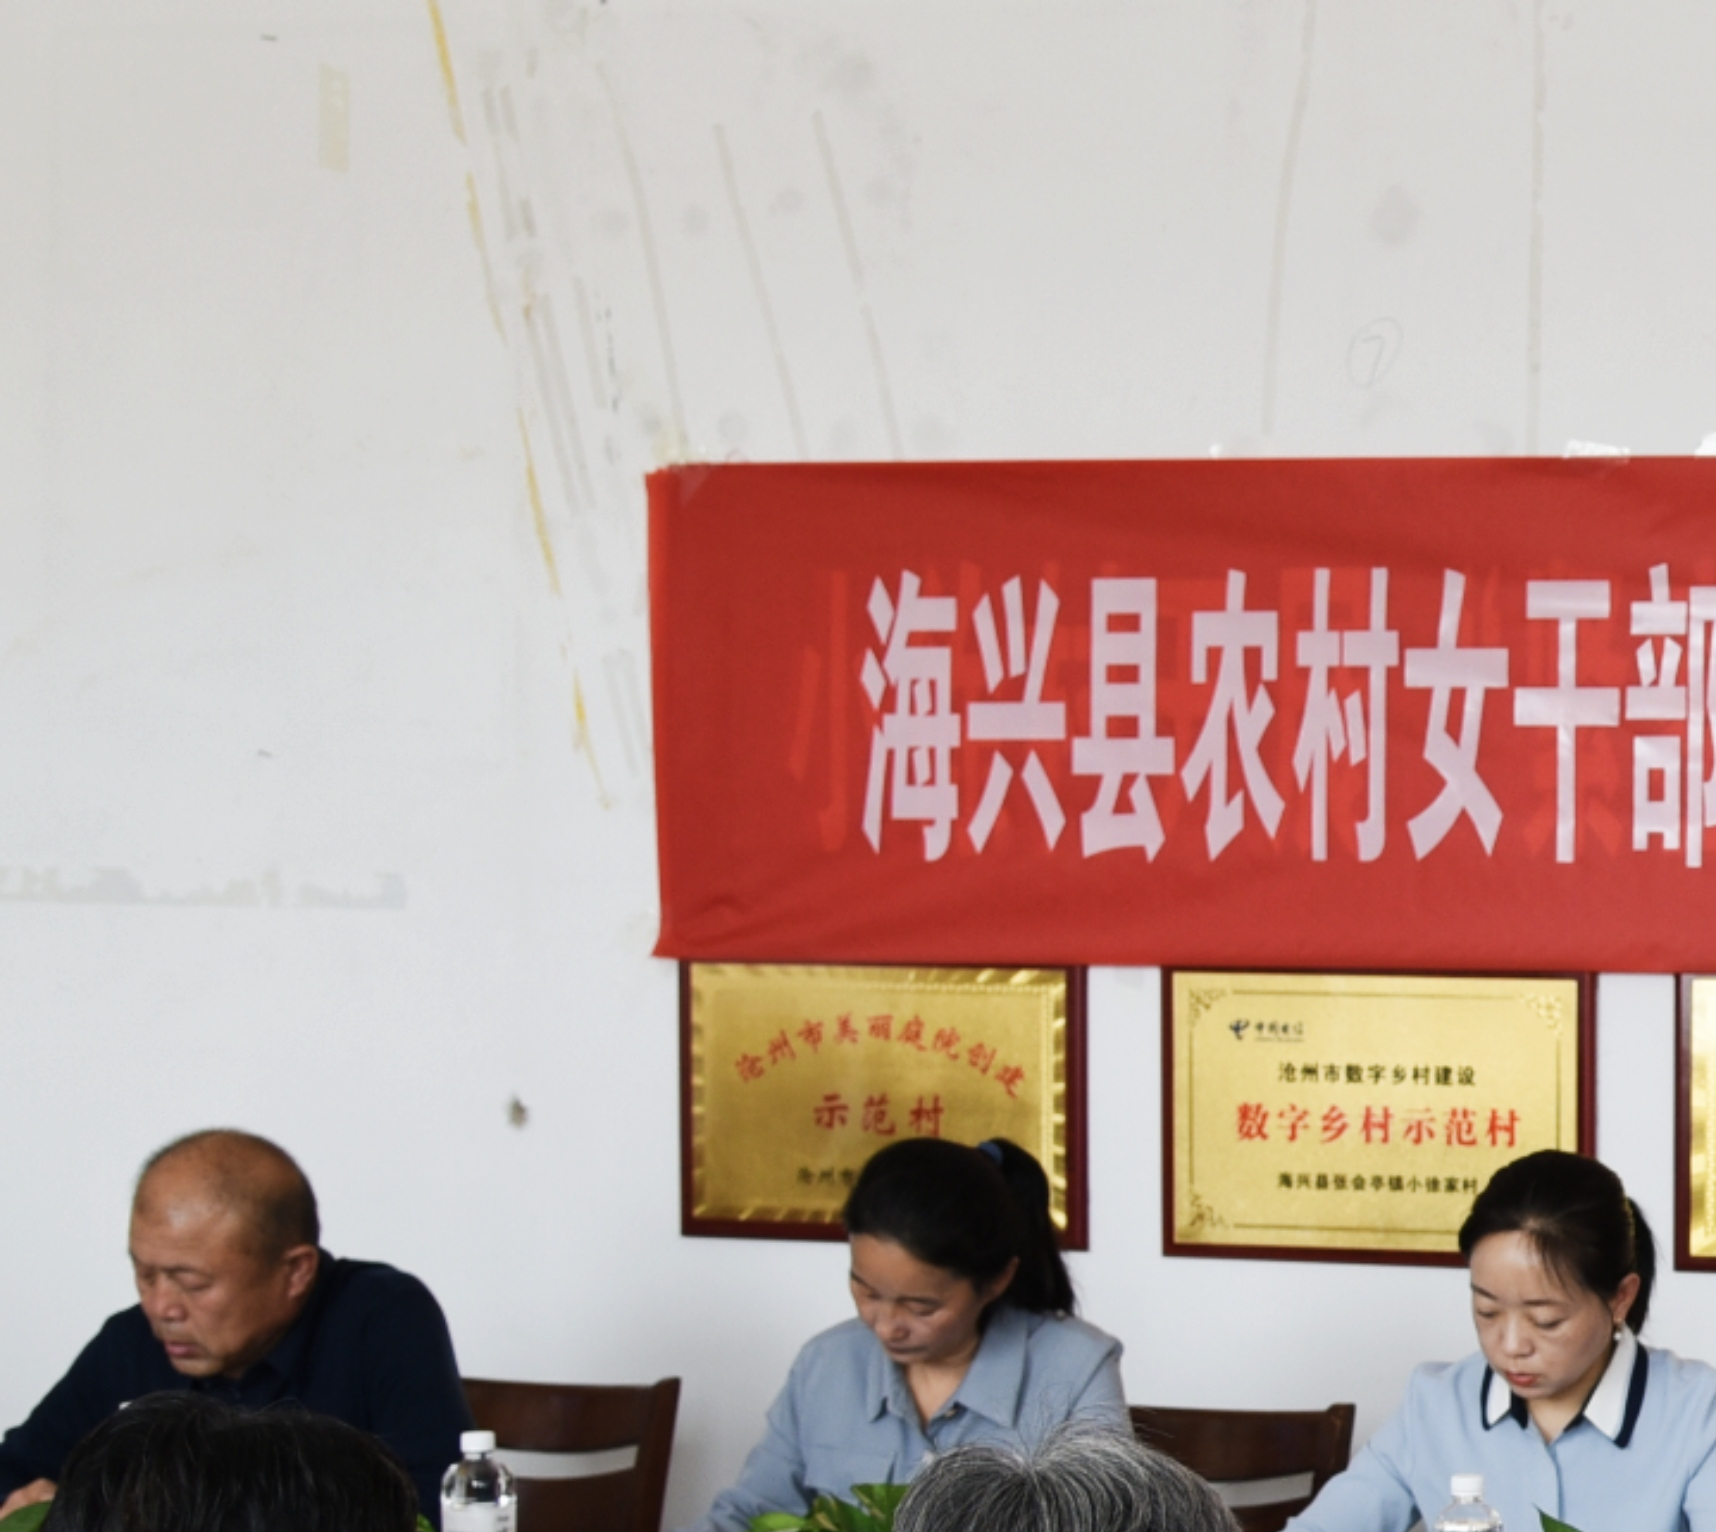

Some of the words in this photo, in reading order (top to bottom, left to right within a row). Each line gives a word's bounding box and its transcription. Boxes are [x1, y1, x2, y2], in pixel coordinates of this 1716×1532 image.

[735, 1010, 1027, 1098] 沧州市美丽庭院创建
[1278, 1062, 1477, 1086] 沧州市数字乡村建设
[813, 1094, 946, 1136] 示范村
[1236, 1101, 1522, 1148] 数字乡村示范村
